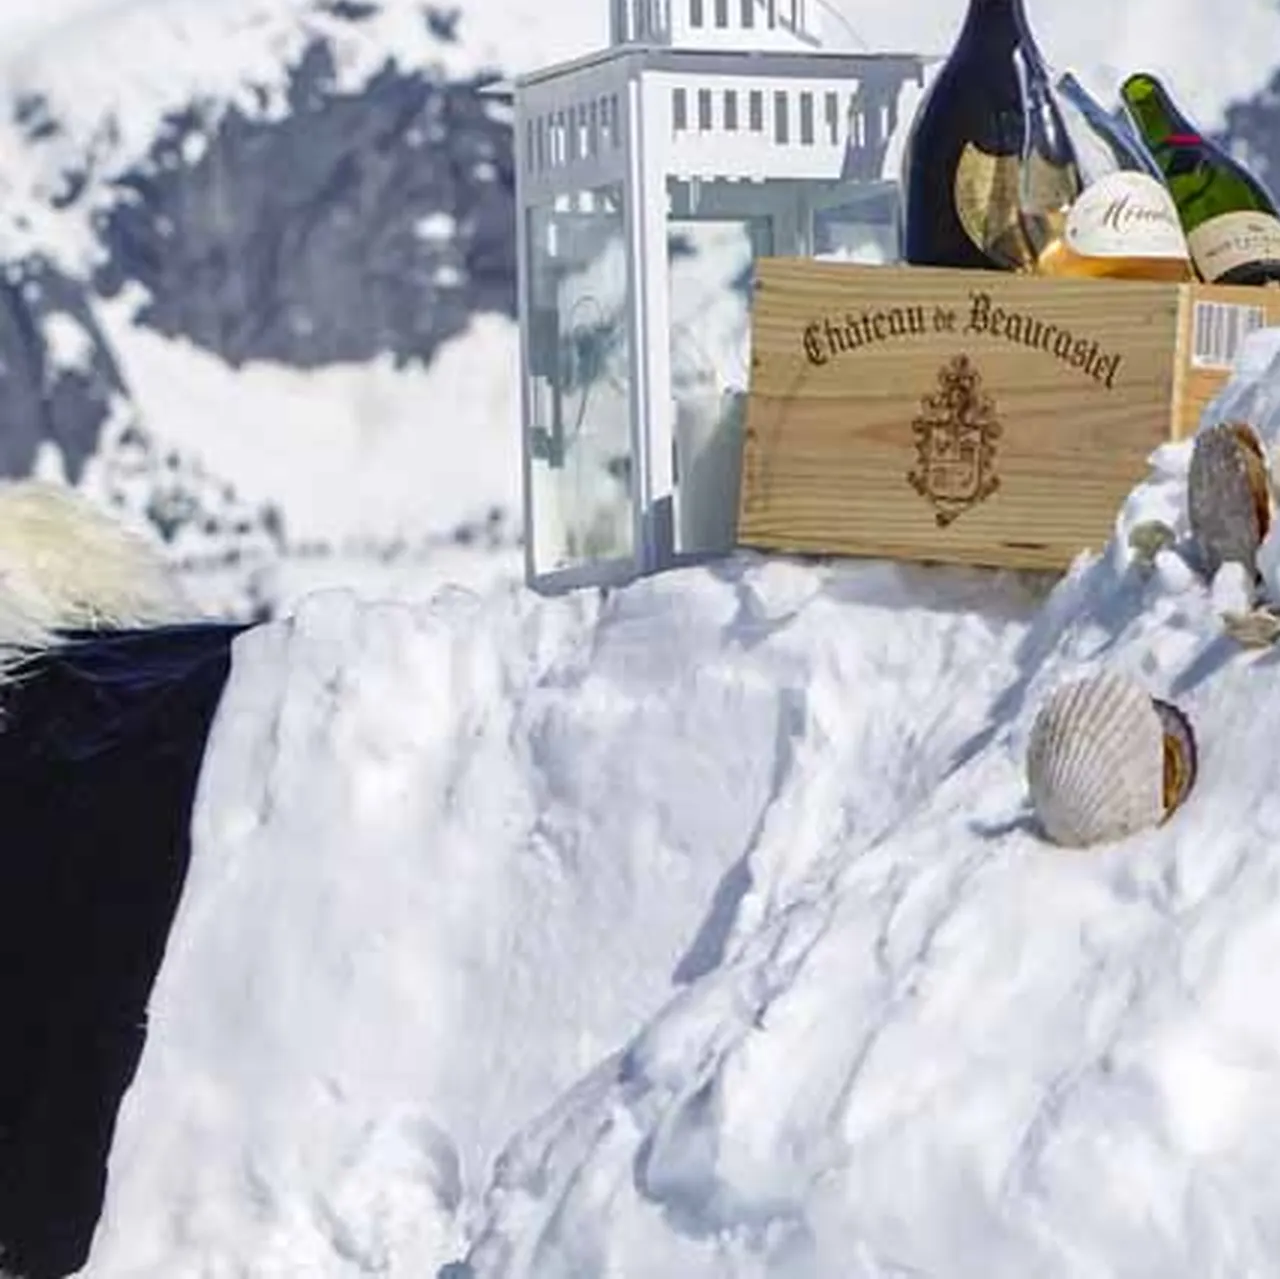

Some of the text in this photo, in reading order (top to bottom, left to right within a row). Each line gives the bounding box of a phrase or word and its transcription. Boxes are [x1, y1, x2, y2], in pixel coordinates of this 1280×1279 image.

[803, 291, 1121, 389] Château de Beaucastel
